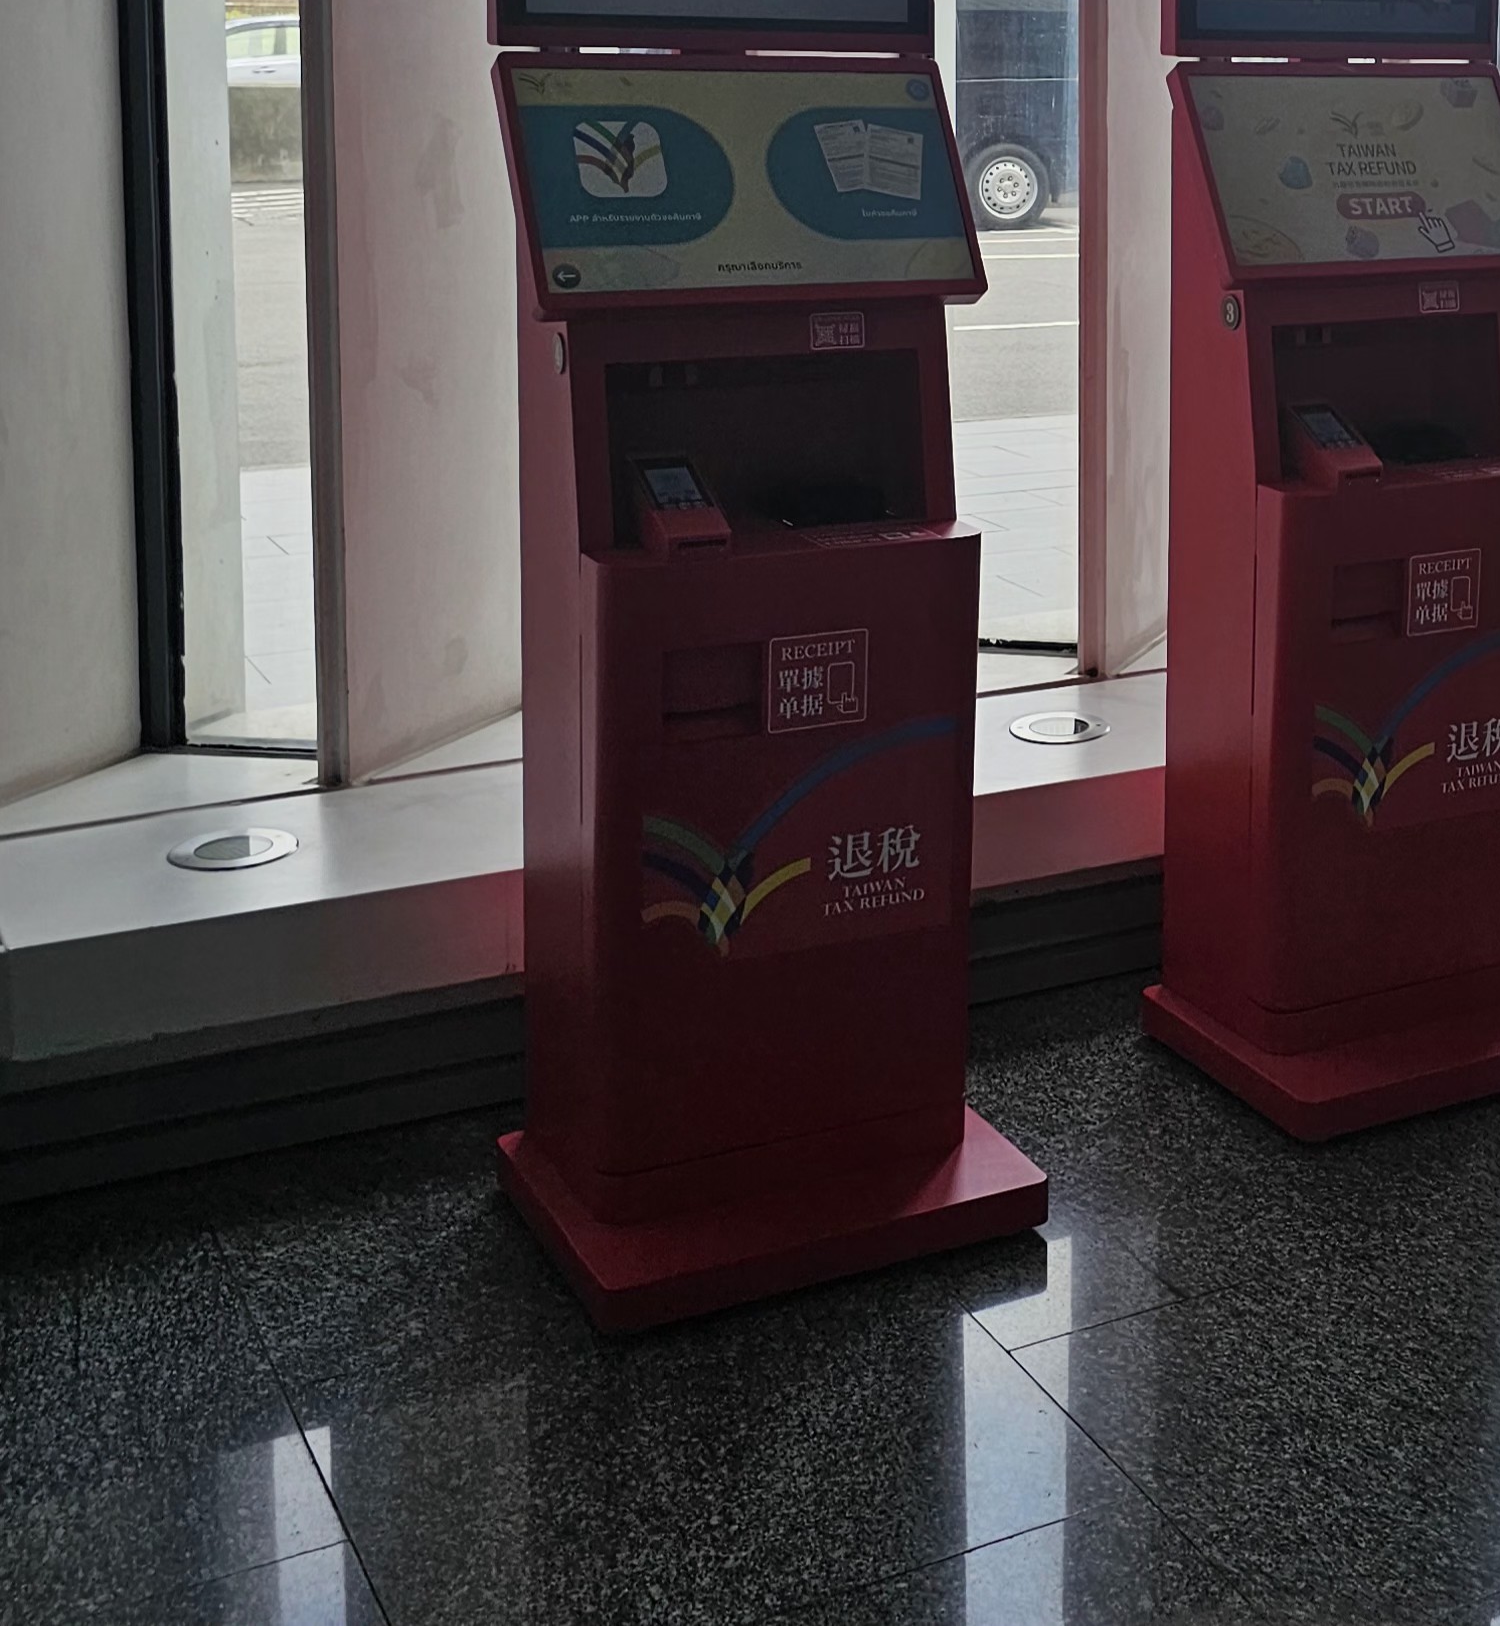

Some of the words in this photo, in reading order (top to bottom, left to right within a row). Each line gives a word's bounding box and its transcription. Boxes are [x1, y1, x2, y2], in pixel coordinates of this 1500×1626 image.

[1336, 142, 1398, 158] TAIWAN
[1326, 161, 1357, 177] TAX
[1357, 160, 1418, 176] REFUND
[1348, 196, 1413, 216] START
[569, 214, 589, 223] APP
[1226, 302, 1235, 323] 3
[1418, 557, 1473, 576] RECEIPT
[781, 638, 857, 662] RECEIPT
[777, 692, 824, 719] 单据
[1441, 778, 1465, 794] TAX
[827, 824, 922, 882] 退稅
[842, 876, 908, 899] TAIWAN
[821, 899, 856, 917] TAX
[859, 887, 926, 910] REFUND
